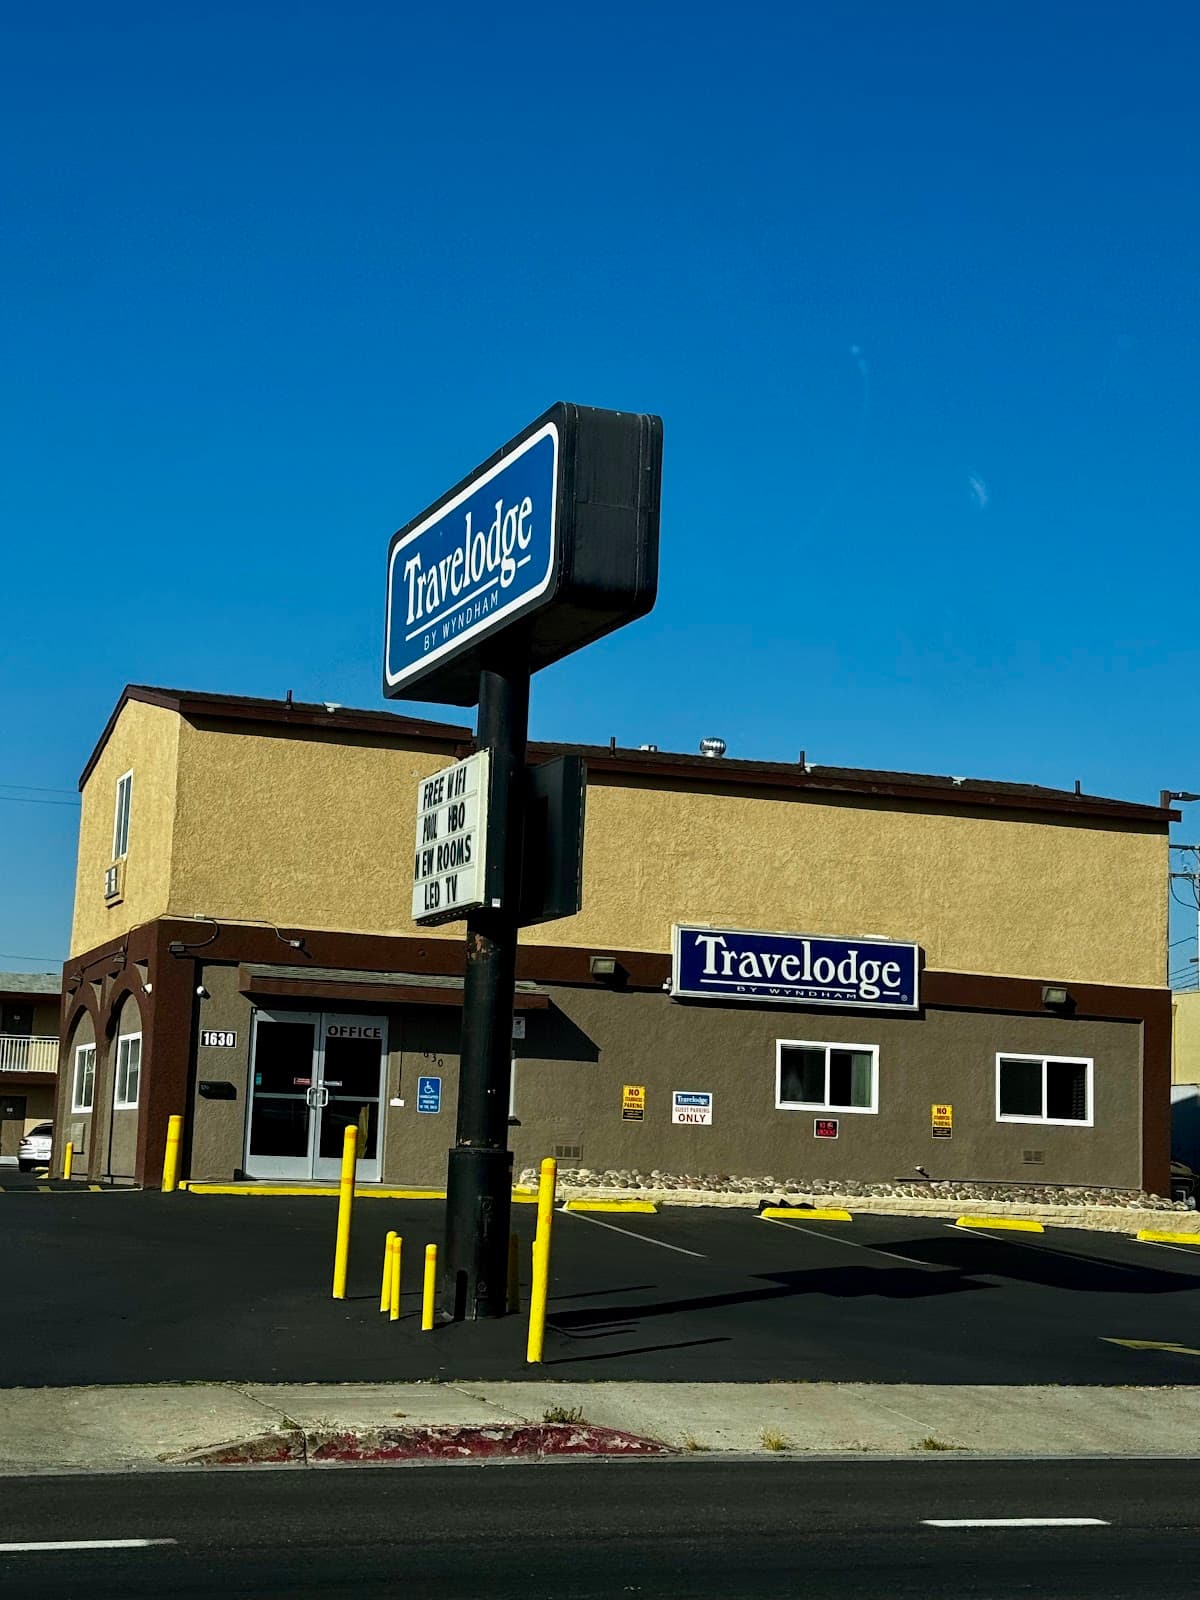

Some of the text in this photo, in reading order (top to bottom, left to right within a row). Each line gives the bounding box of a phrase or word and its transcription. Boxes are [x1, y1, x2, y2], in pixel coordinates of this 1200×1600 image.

[403, 496, 533, 626] Travelodge
[423, 590, 499, 651] BY WYNDHAM
[423, 776, 445, 811] FREE
[436, 834, 472, 873] ROOMS
[424, 874, 459, 911] LED TV
[694, 934, 901, 999] Travelodge
[736, 985, 857, 999] BY WYNDHAM
[203, 1032, 234, 1047] 1630
[327, 1025, 382, 1039] OFFICE
[678, 1113, 706, 1123] ONLY
[936, 1107, 947, 1115] NO
